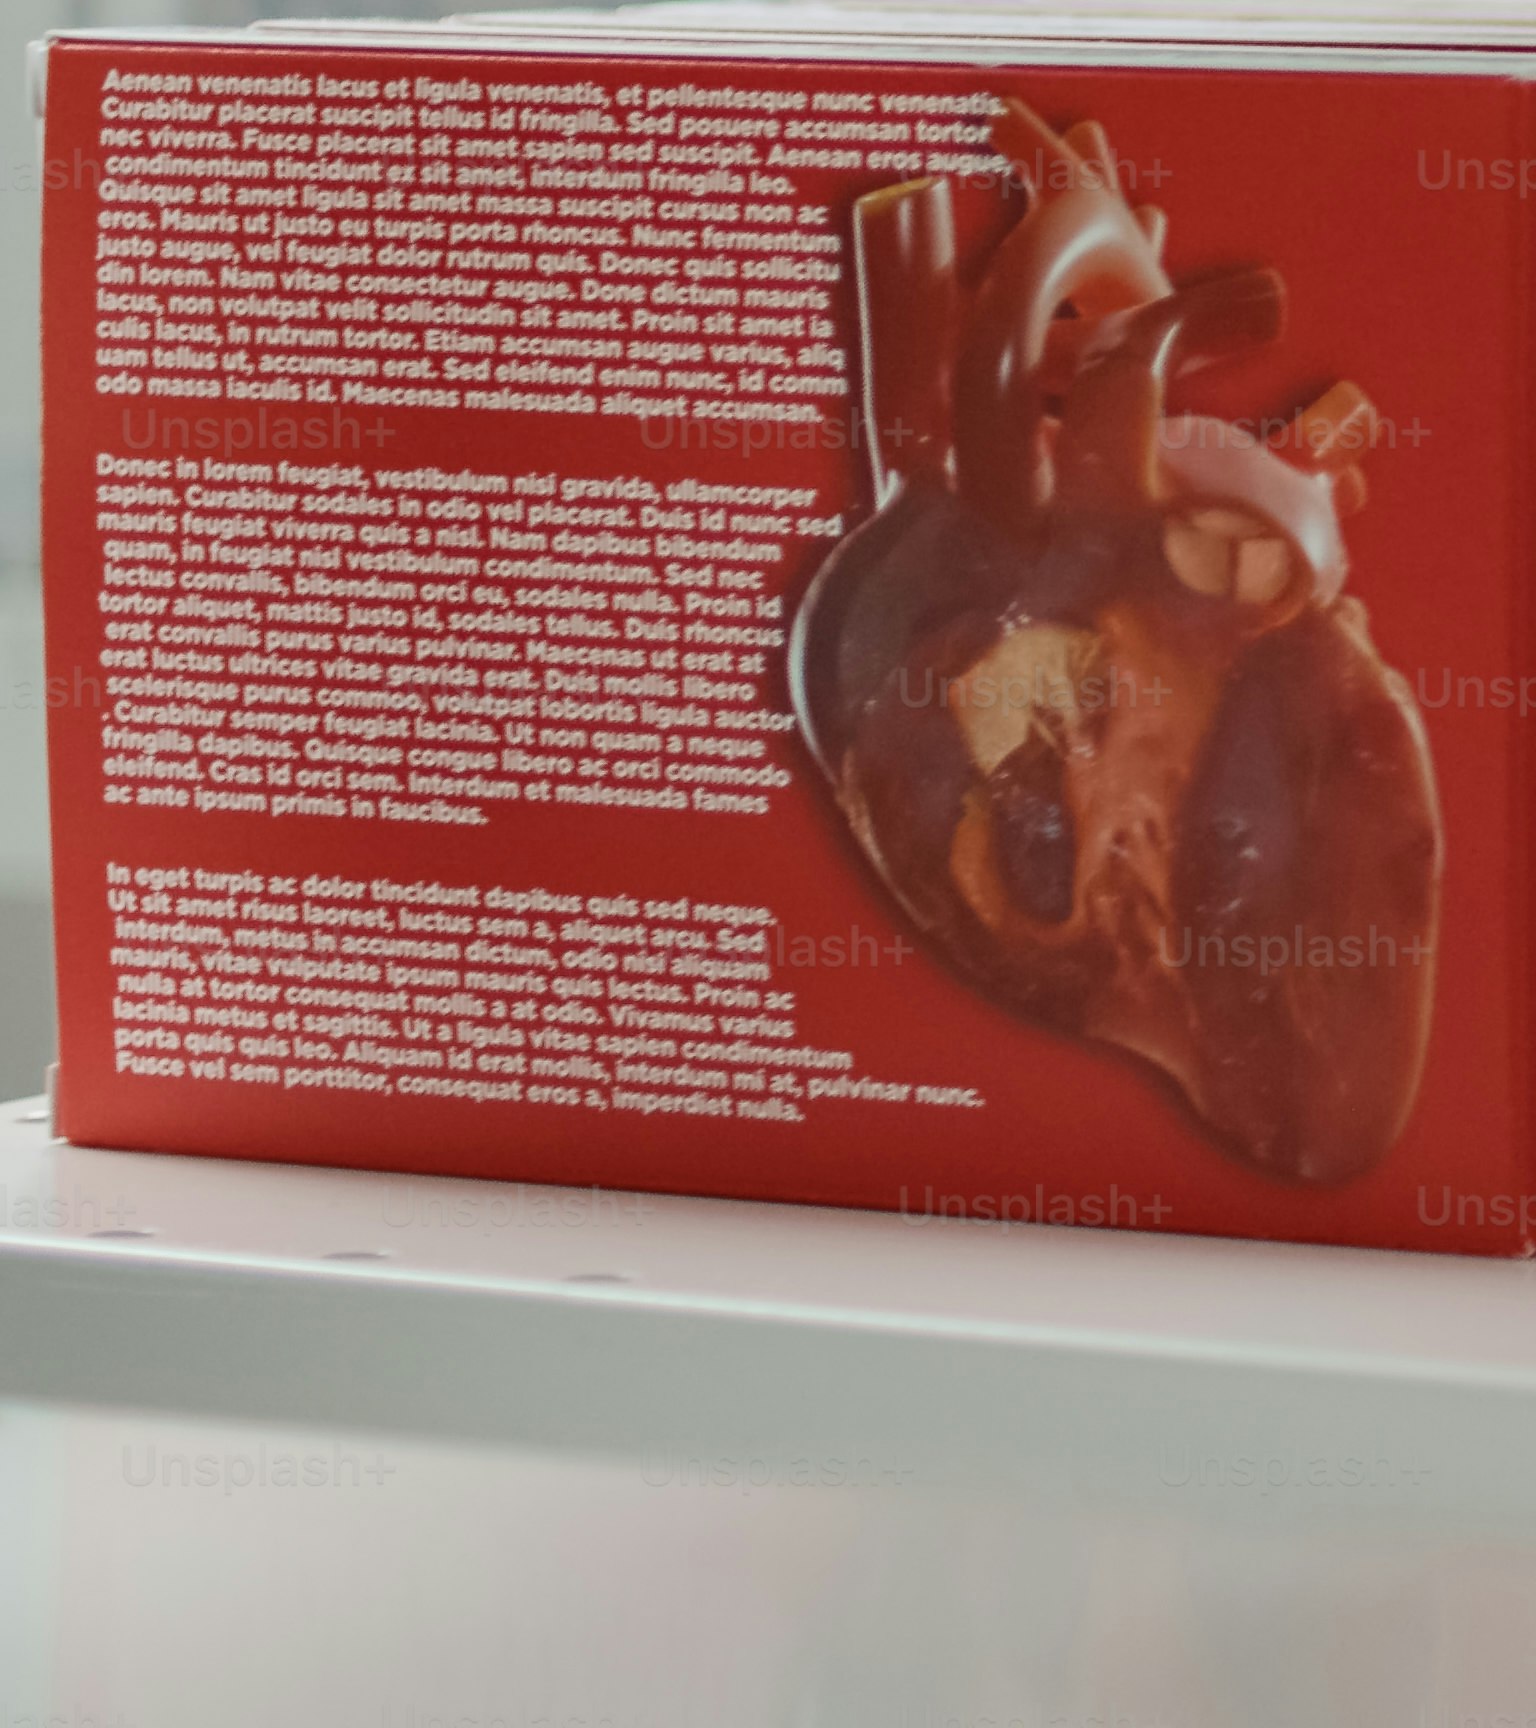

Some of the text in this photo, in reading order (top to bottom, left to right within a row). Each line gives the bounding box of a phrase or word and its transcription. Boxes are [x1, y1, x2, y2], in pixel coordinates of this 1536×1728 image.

[100, 67, 193, 92] Aenean
[196, 70, 312, 96] venenatis
[315, 73, 380, 98] lacus
[382, 77, 410, 99] et
[413, 76, 483, 107] ligula
[614, 83, 644, 105] et
[646, 82, 808, 116] pellentesque
[811, 92, 875, 111] nunc
[100, 94, 216, 121] Curabitur
[216, 98, 318, 130] placerat
[320, 101, 416, 133] suscipit
[418, 104, 486, 129] tellus
[488, 106, 516, 130] id
[626, 110, 676, 134] Sed
[678, 116, 782, 143] posuere
[784, 119, 912, 141] accumsan
[914, 120, 994, 143] tortor
[103, 150, 270, 178] condimentum
[272, 155, 384, 182] tincidunt
[419, 160, 452, 184] sit
[646, 167, 745, 199] fringilla
[160, 207, 241, 232] Mauris
[243, 212, 271, 234] ut
[272, 211, 336, 242] justo
[338, 218, 370, 237] eu
[373, 214, 447, 245] turpis
[449, 218, 519, 248] porta
[631, 223, 698, 248] Nunc
[700, 225, 842, 253] fermentum
[95, 259, 135, 284] din
[219, 264, 276, 289] Nam
[279, 266, 342, 291] vitae
[344, 270, 490, 297] consectetur
[580, 277, 647, 302] Done
[649, 280, 740, 306] dictum
[742, 283, 830, 309] mauris
[94, 369, 144, 394] odo
[146, 376, 222, 398] massa
[225, 375, 302, 401] iaculis
[341, 380, 461, 408] Maecenas
[463, 385, 597, 413] malesuada
[599, 390, 689, 423] aliquet
[96, 451, 173, 478] Donec
[175, 455, 200, 479] in
[203, 456, 274, 482] lorem
[373, 464, 510, 493] vestibulum
[665, 477, 818, 513] ullamcorper
[96, 506, 178, 533] mauris
[180, 510, 268, 543] feugiat
[270, 515, 356, 542] viverra
[358, 519, 412, 550] quis
[414, 526, 433, 545] a
[489, 525, 549, 551] Nam
[551, 528, 652, 562] dapibus
[655, 533, 783, 562] bibendum
[104, 618, 155, 641] erat
[156, 618, 262, 647] convallis
[263, 629, 335, 657] purus
[336, 628, 412, 655] varius
[525, 638, 647, 667] Maecenas
[649, 647, 679, 669] ut
[681, 648, 735, 672] erat
[737, 651, 766, 674] at
[103, 784, 134, 804] ac
[136, 783, 191, 807] ante
[194, 784, 268, 818] ipsum
[271, 789, 349, 822] primis
[350, 794, 376, 818] in
[106, 860, 132, 884] In
[134, 864, 192, 894] eget
[193, 865, 266, 899] turpis
[268, 875, 299, 895] ac
[300, 872, 368, 899] dolor
[369, 876, 482, 906] tincidunt
[483, 884, 584, 919] dapibus
[586, 890, 641, 923] quis
[643, 894, 690, 920] sed
[233, 924, 310, 950] metus
[311, 928, 338, 952] in
[339, 934, 461, 960] accumsan
[560, 944, 619, 971] odio
[669, 951, 771, 987] aliquam
[115, 1048, 186, 1076] Fusce
[188, 1054, 226, 1080] vel
[229, 1062, 280, 1084] sem
[395, 1071, 523, 1107] consequat
[525, 1084, 581, 1106] eros
[611, 1085, 734, 1123] imperdiet
